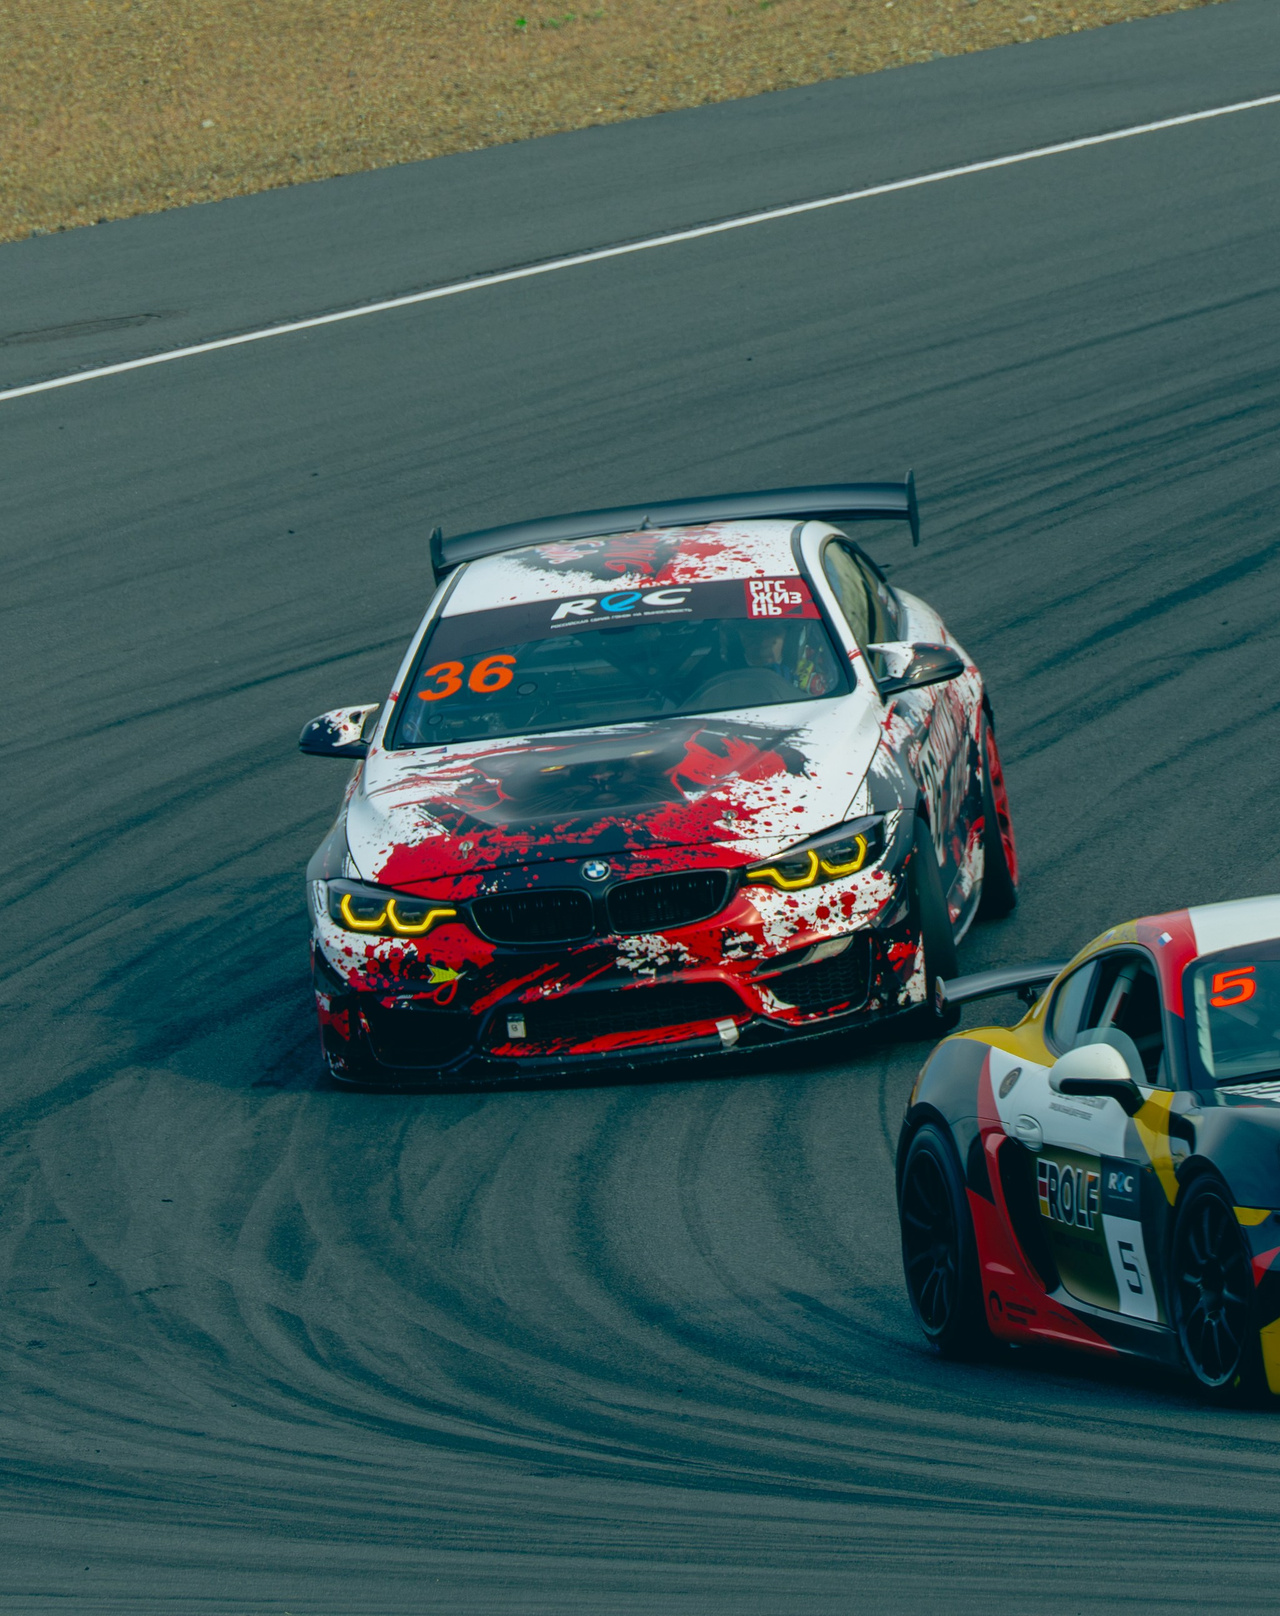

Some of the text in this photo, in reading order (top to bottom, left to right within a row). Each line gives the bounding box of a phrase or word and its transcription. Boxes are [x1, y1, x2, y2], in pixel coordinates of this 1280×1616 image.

[749, 580, 787, 592] РГС
[750, 592, 803, 604] ЖИЗ
[752, 603, 782, 616] НЬ
[417, 654, 517, 702] 36
[1210, 965, 1257, 1008] 5
[1048, 1162, 1100, 1231] ROLF
[1117, 1240, 1143, 1295] 5
